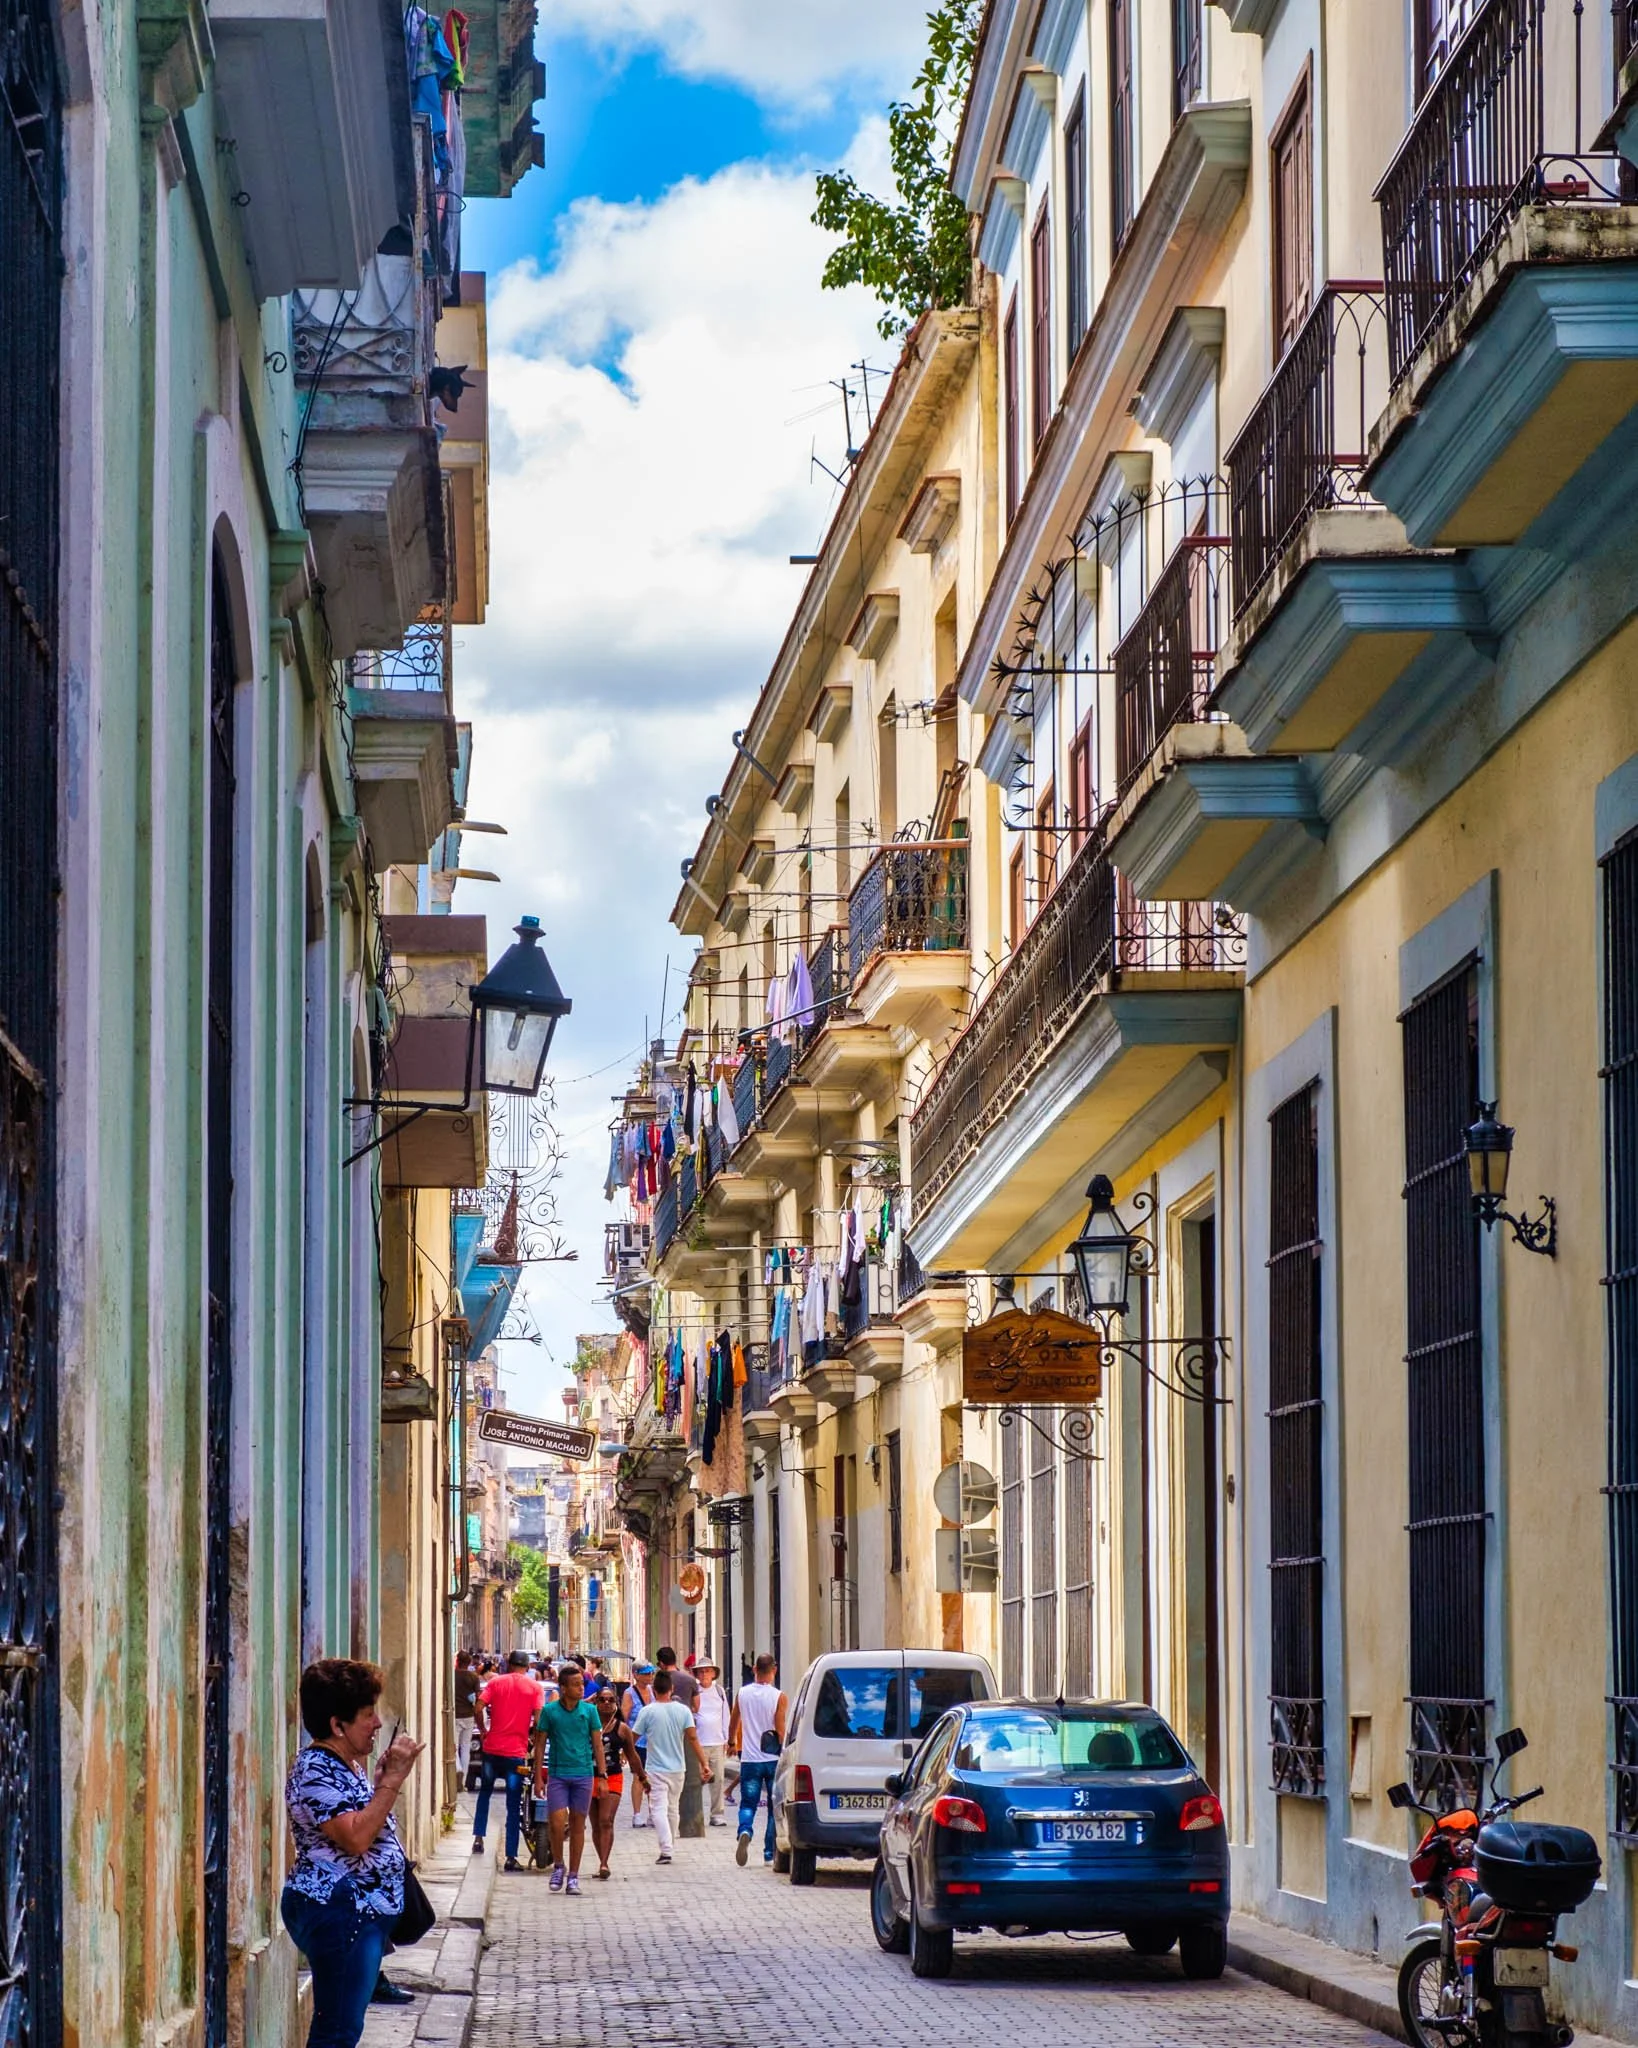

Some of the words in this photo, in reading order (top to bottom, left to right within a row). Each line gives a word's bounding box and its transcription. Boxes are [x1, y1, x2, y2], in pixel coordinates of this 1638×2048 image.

[485, 1427, 507, 1439] JOSE
[508, 1432, 544, 1446] ANTONIO
[545, 1441, 586, 1454] MACHADO
[506, 1421, 537, 1434] Escuela
[538, 1428, 570, 1441] Primaria
